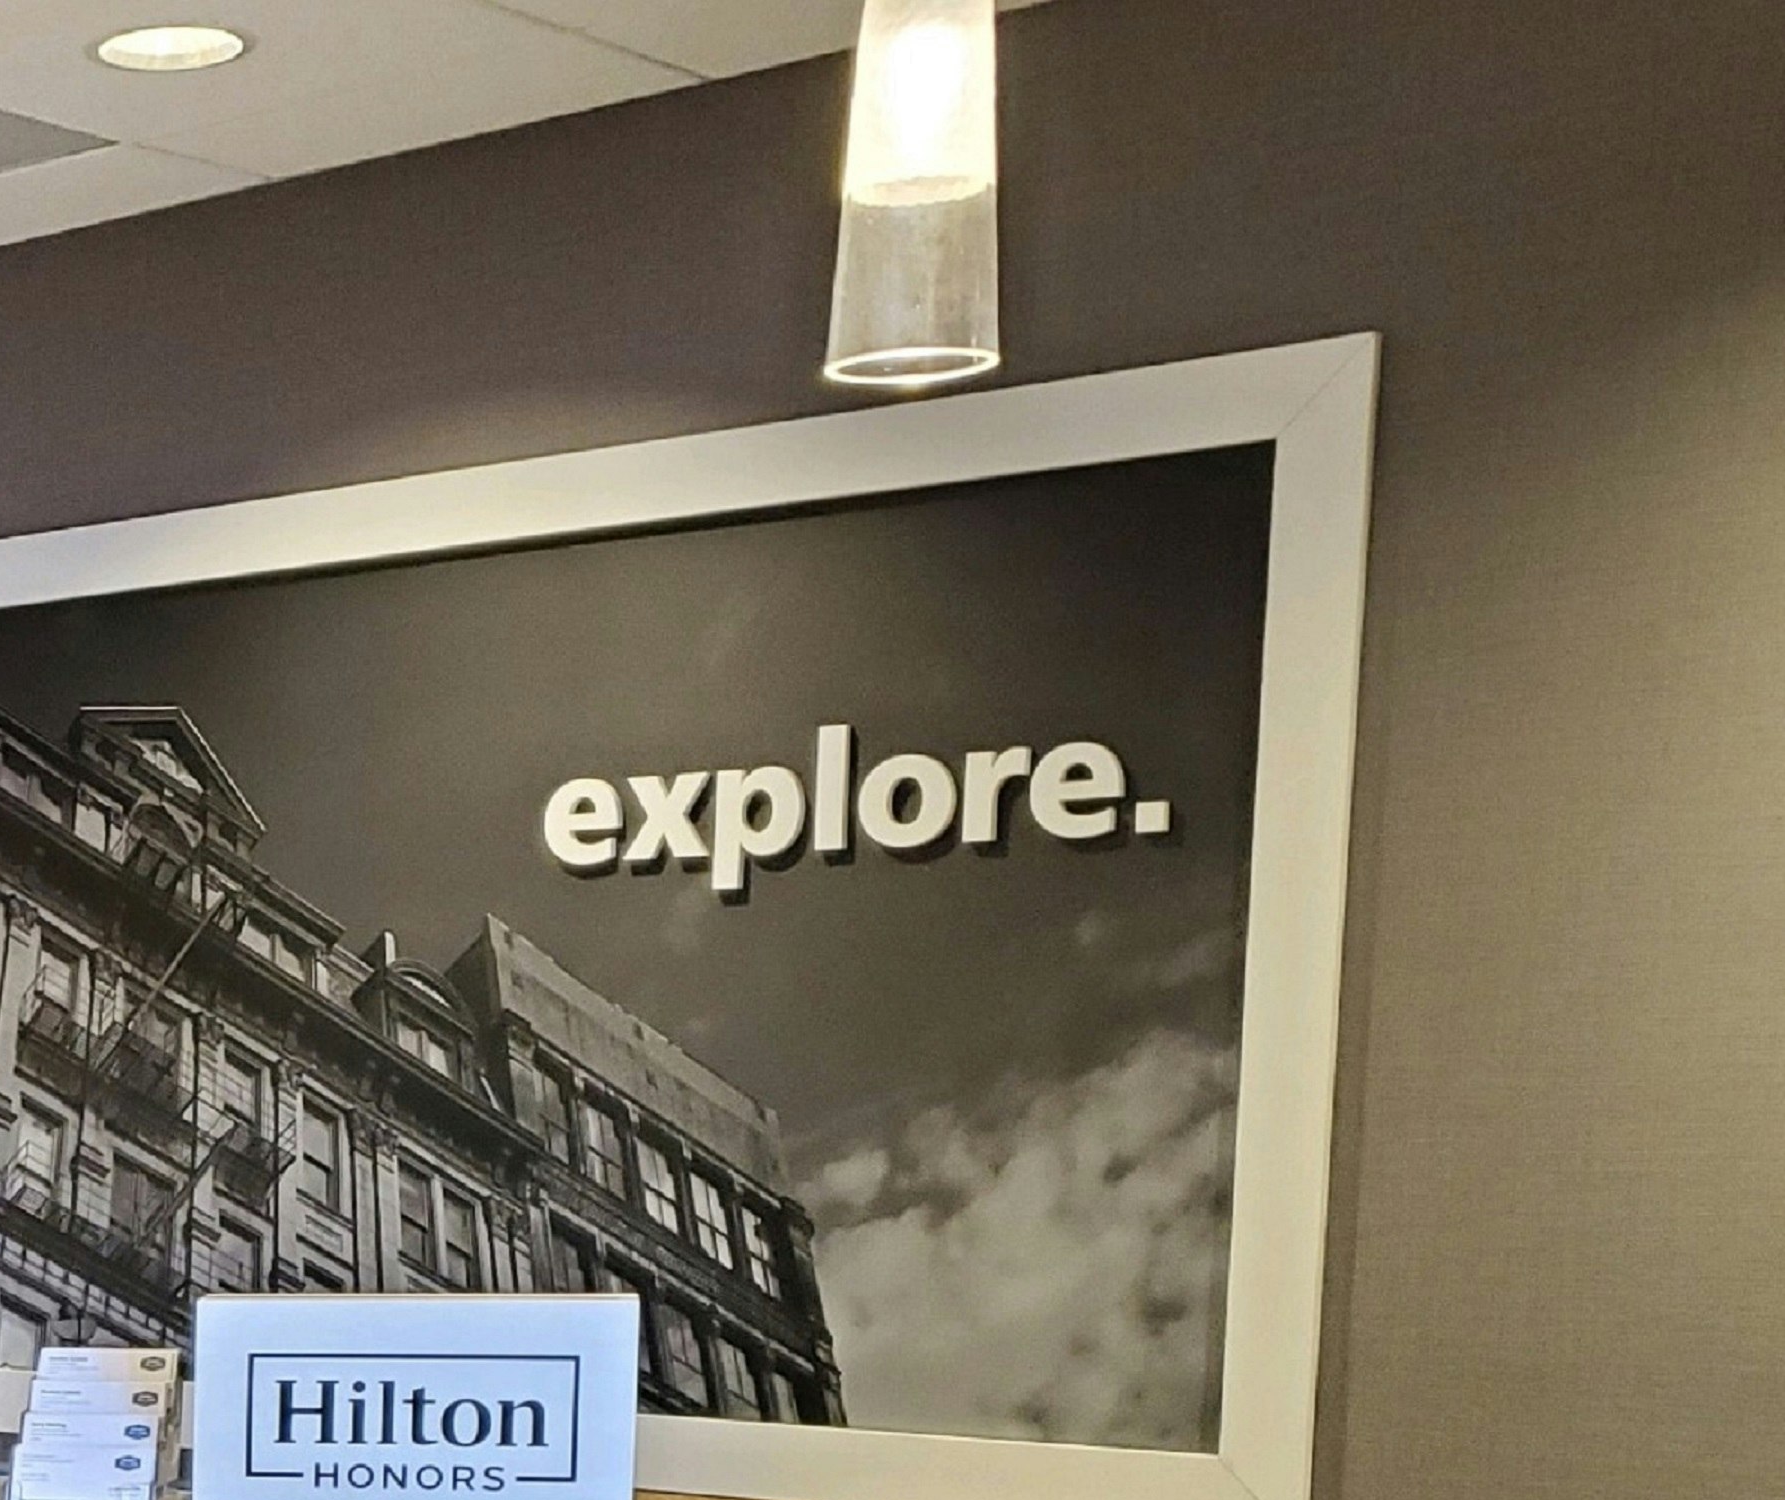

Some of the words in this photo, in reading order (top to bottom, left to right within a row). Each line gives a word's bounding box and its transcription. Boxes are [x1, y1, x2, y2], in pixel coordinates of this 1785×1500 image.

[543, 723, 1170, 890] explore.
[272, 1379, 550, 1448] Hilton
[313, 1461, 507, 1492] HONORS
